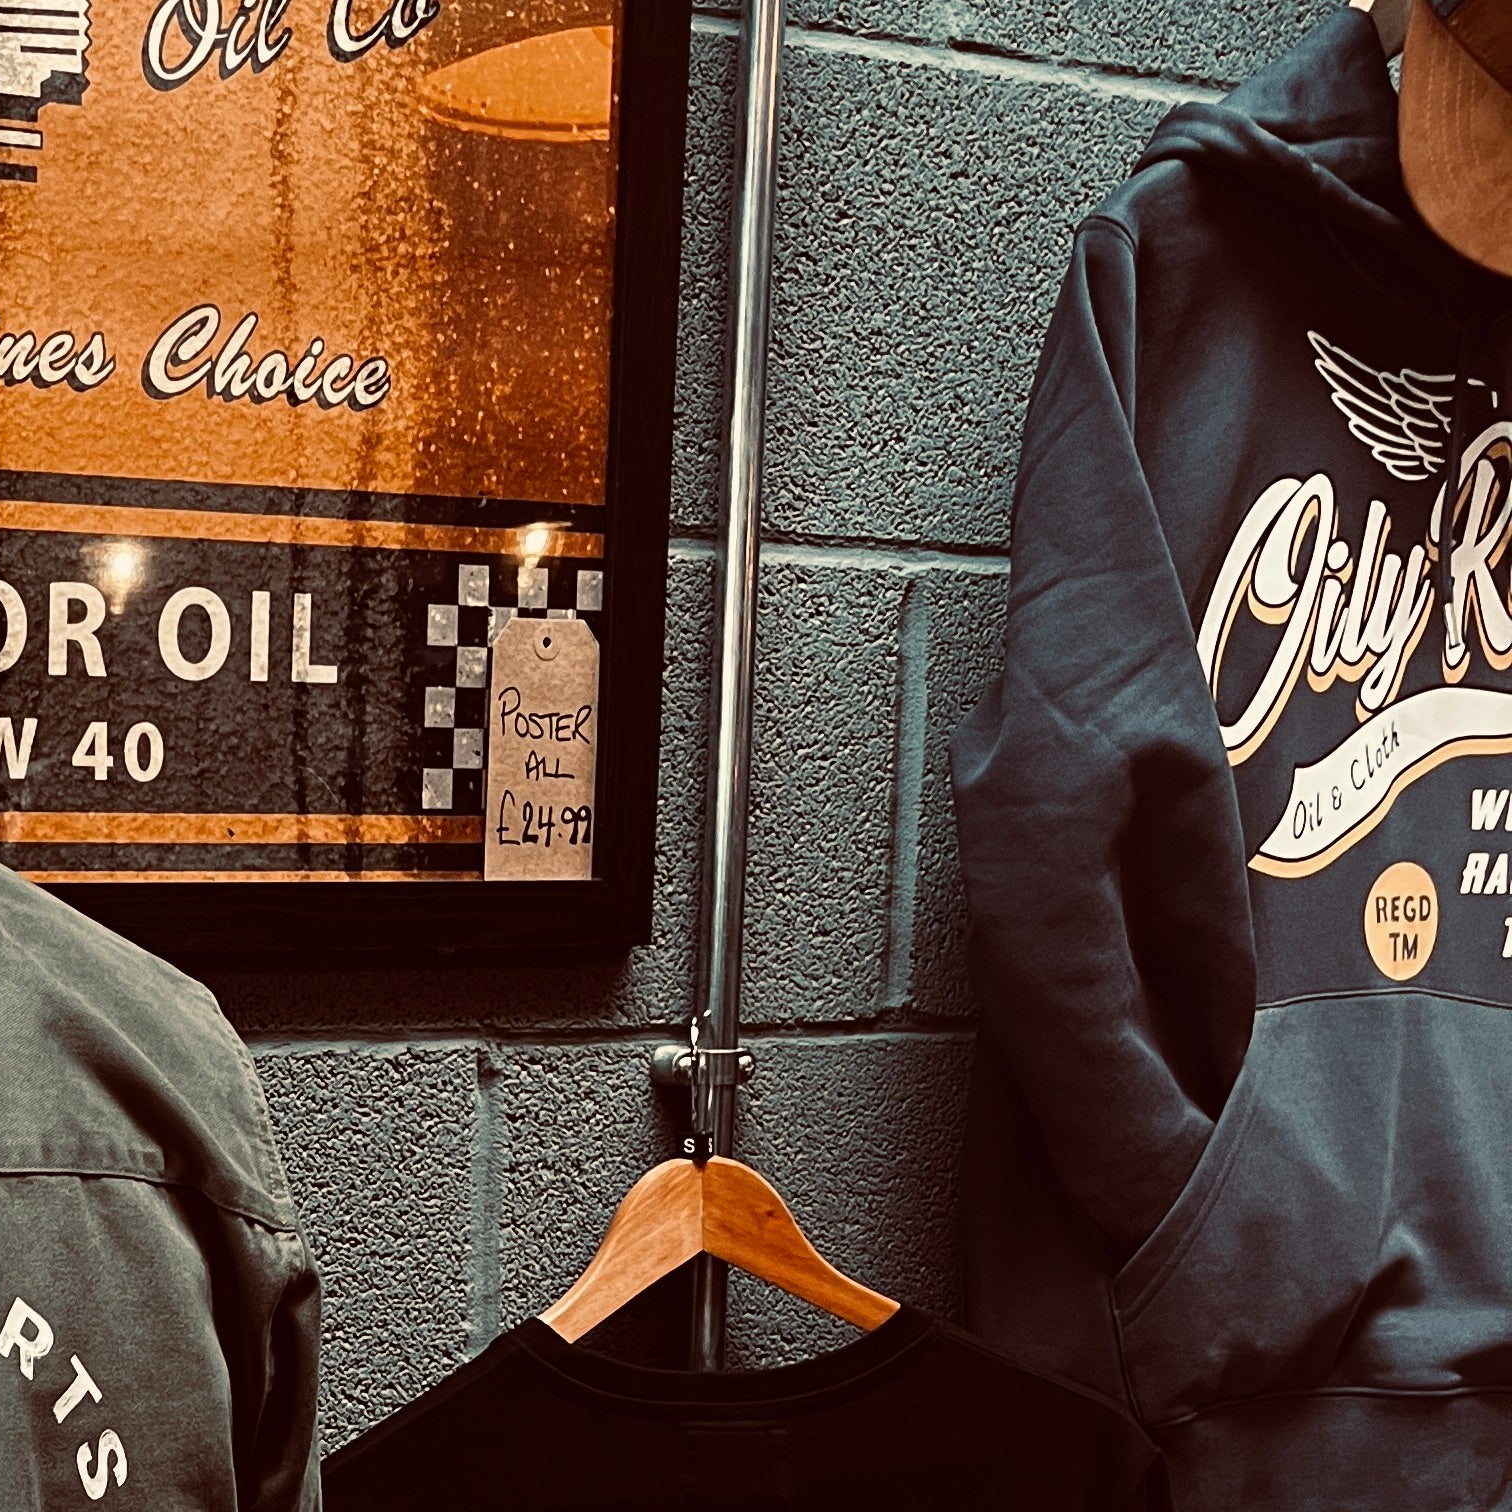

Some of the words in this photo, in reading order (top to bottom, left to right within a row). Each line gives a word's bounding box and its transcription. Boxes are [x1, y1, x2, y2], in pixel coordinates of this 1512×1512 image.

[140, 0, 296, 94] Oil
[141, 303, 394, 414] Choice
[157, 586, 338, 684] OIL
[1196, 472, 1438, 766] Oily
[498, 686, 593, 745] POSTER
[71, 721, 164, 783] 40
[524, 750, 575, 781] ALL
[1291, 798, 1326, 842] Oil
[1331, 784, 1345, 808] &
[1348, 718, 1402, 792] Cloth
[496, 789, 595, 851] £24.99
[1471, 788, 1512, 832] W
[1372, 892, 1434, 928] REGD
[1386, 928, 1422, 966] TM
